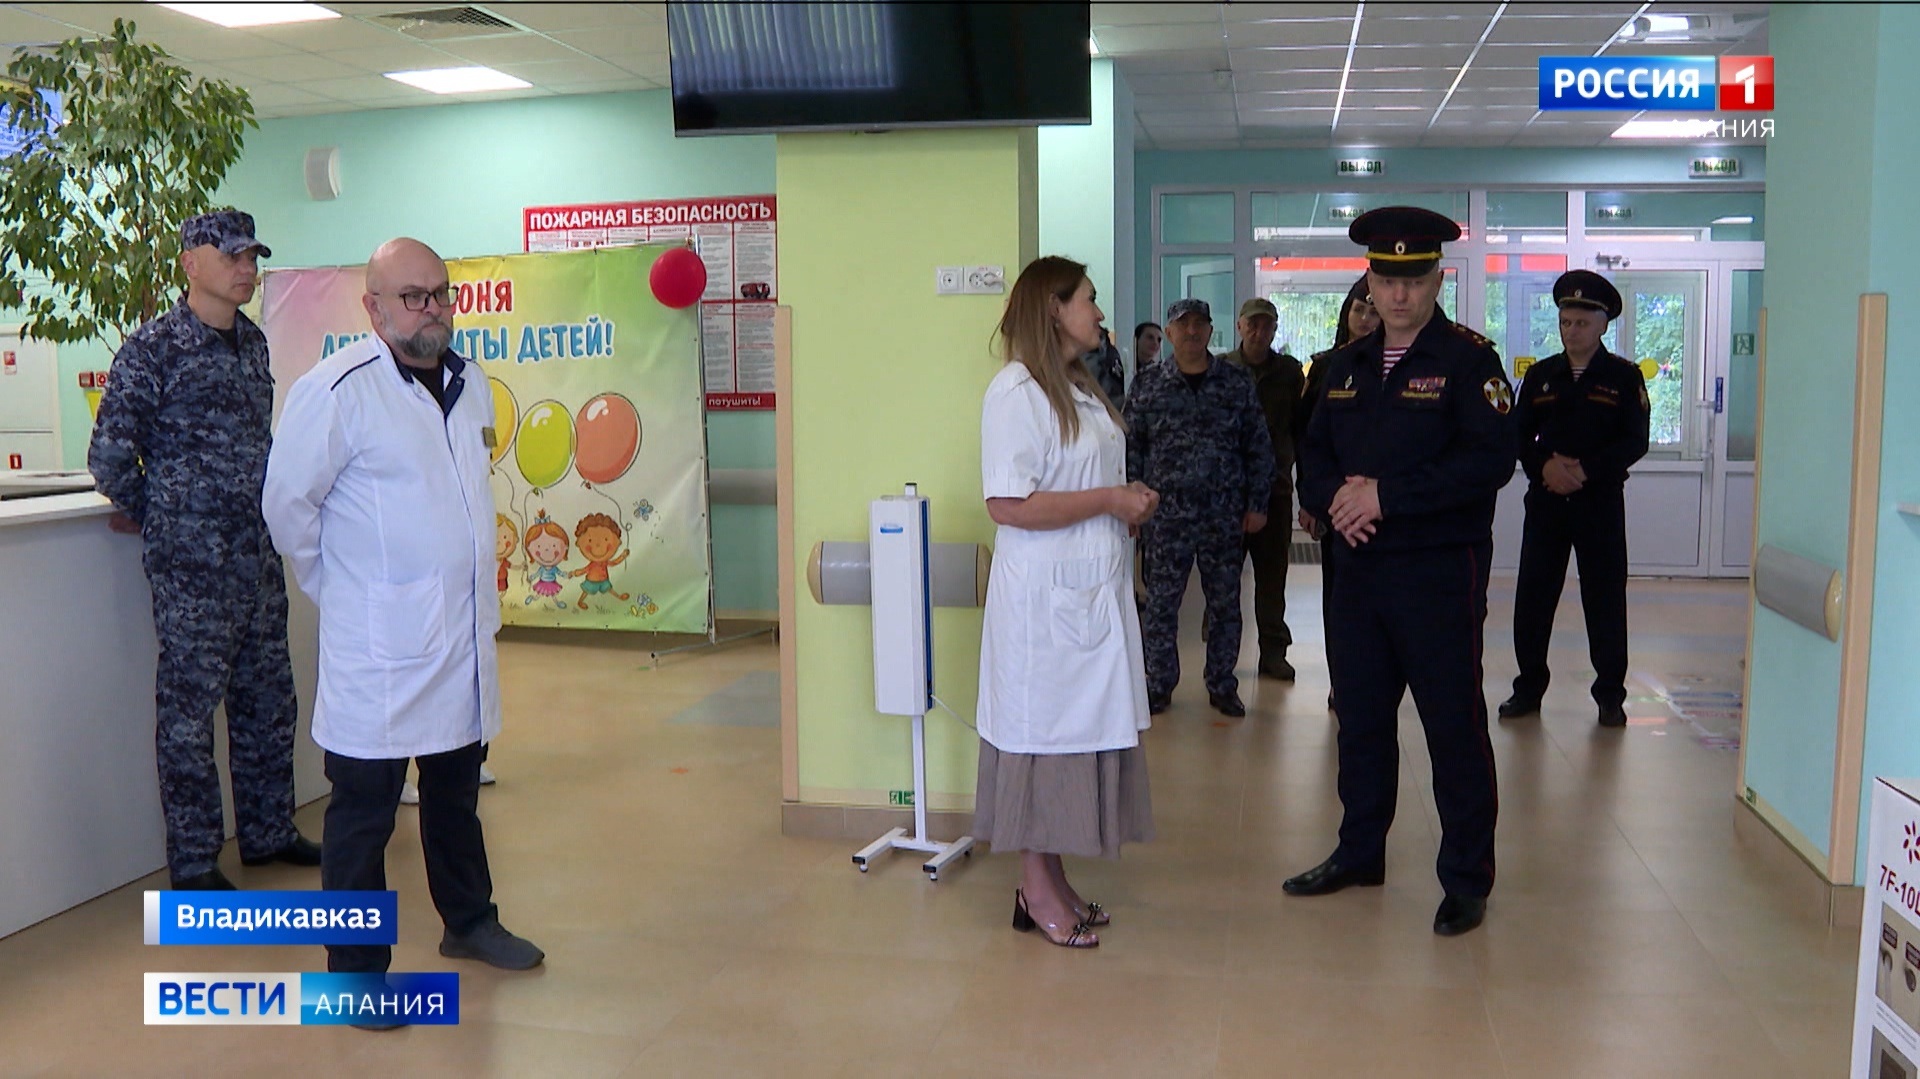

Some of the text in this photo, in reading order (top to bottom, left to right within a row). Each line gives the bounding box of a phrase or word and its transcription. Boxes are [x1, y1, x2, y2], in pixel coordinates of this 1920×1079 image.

[1340, 161, 1382, 173] ВЫХОД
[1694, 159, 1737, 173] ВЫХОД
[530, 202, 772, 229] ПОЖАРНАЯ БЕЗОПАСНОСТЬ
[451, 280, 512, 313] ЮНЯ
[448, 316, 613, 363] ИТЫ ДЕТЕЙ!
[708, 395, 761, 407] потушить!
